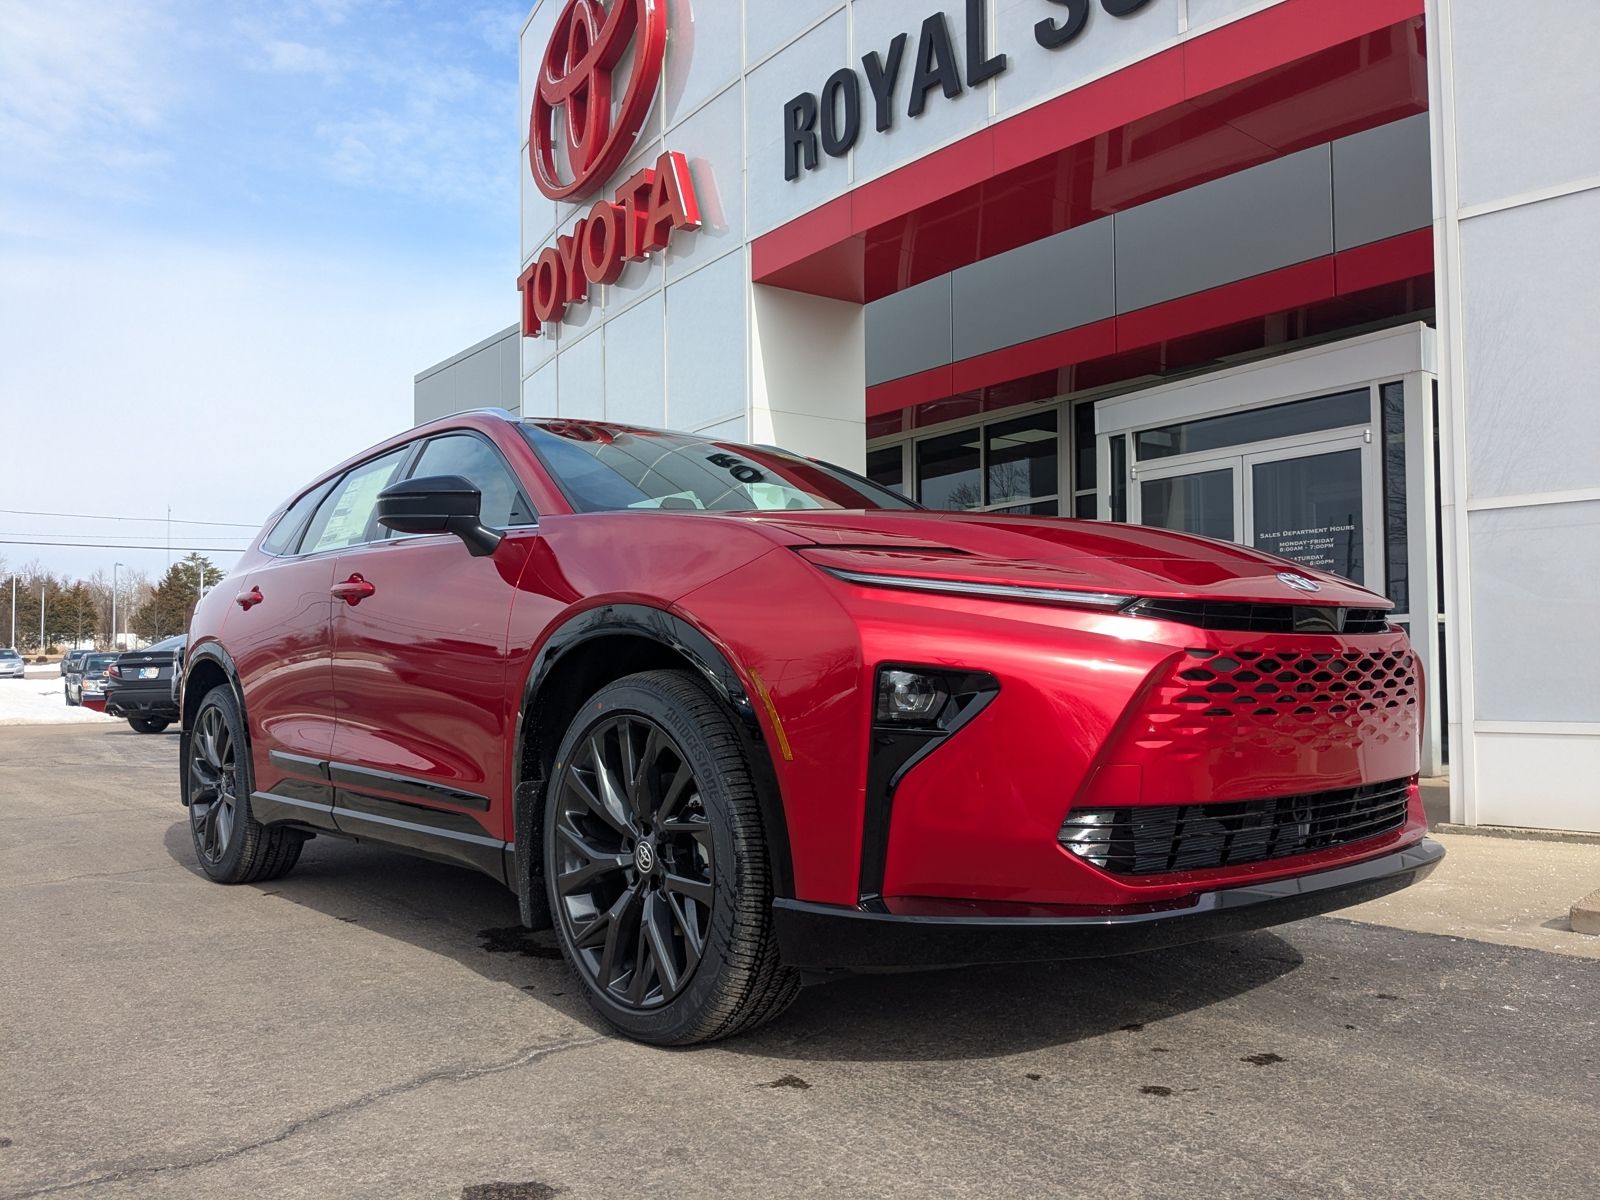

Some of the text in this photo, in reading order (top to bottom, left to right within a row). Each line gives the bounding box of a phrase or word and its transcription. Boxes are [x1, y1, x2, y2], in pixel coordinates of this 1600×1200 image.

[784, 0, 1007, 182] ROYAL
[517, 150, 702, 338] TOYOTA
[1279, 537, 1334, 547] MONDAY-FRIDAY
[1282, 527, 1328, 537] DEPARTMENT
[1329, 524, 1355, 532] HOURS
